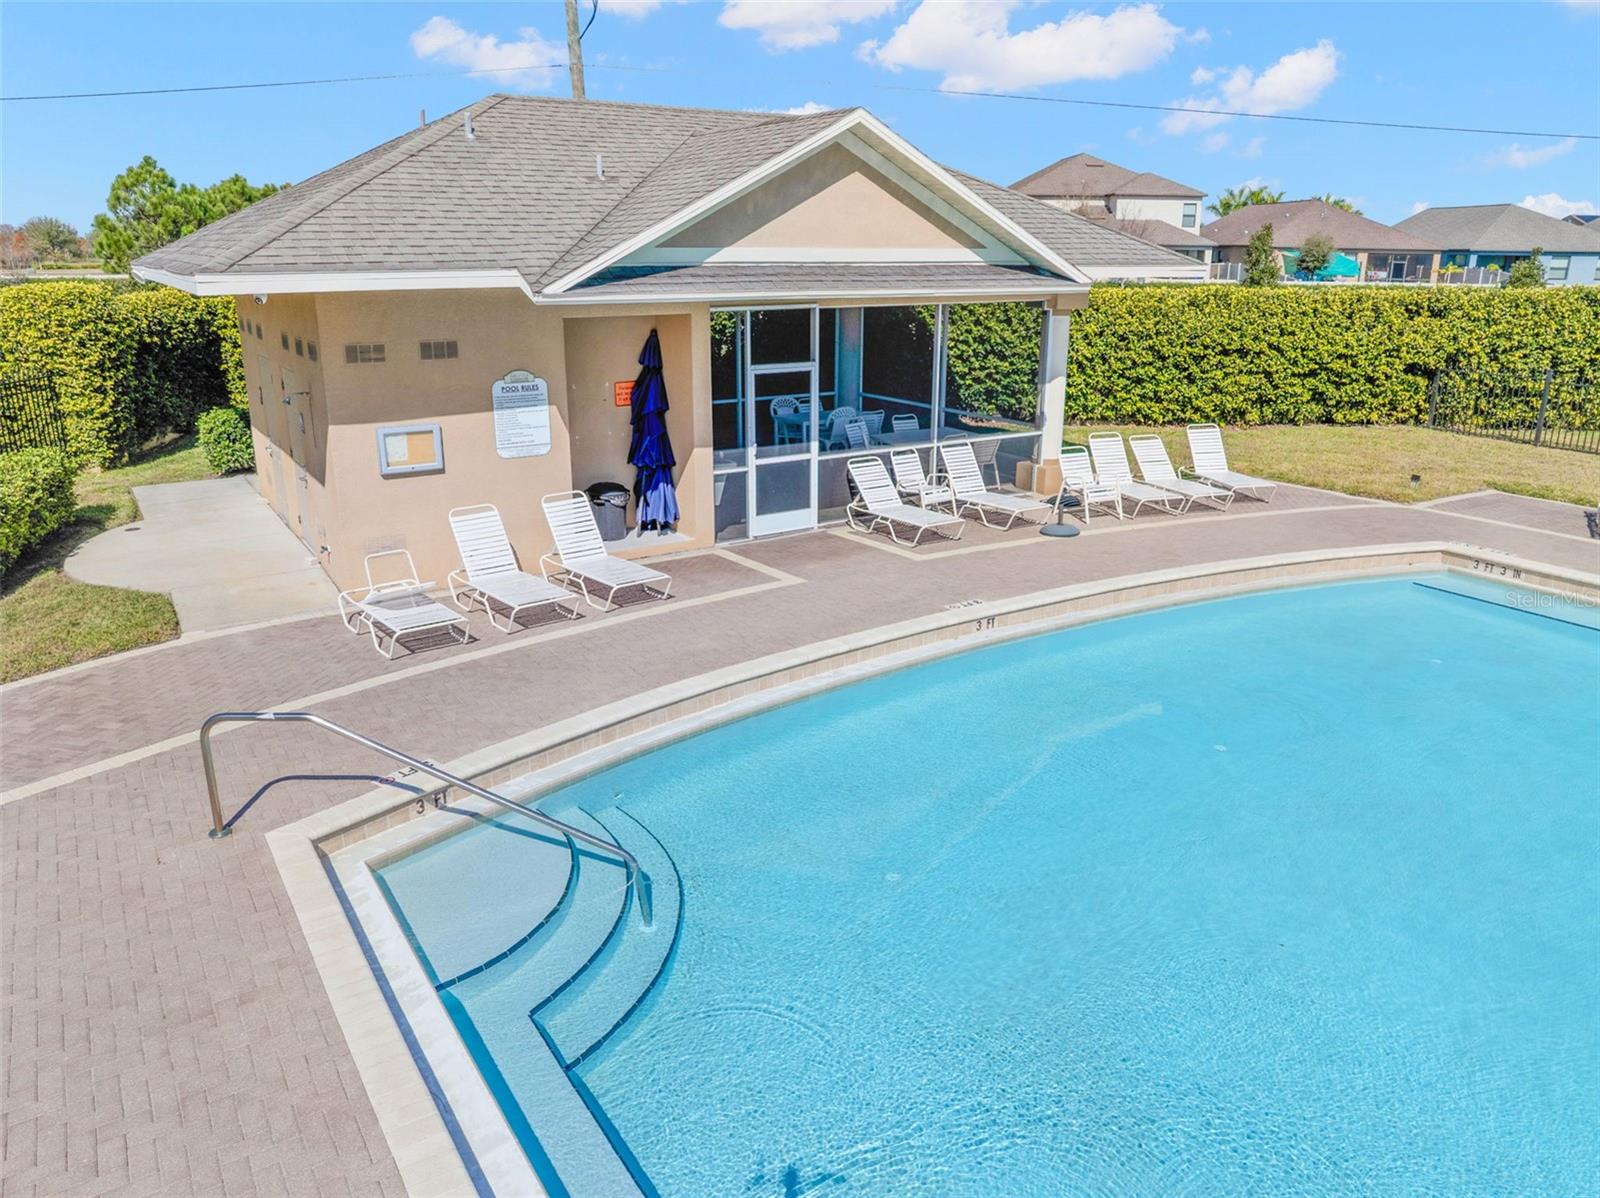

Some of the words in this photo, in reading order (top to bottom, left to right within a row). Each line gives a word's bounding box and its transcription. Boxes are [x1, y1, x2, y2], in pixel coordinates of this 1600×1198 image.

[501, 385, 519, 393] POOL
[521, 384, 539, 392] RULES
[1473, 560, 1479, 569] 3
[1484, 563, 1495, 573] FT
[1500, 566, 1506, 575] 3
[1513, 568, 1522, 578] IN
[976, 620, 982, 631] 3
[986, 617, 995, 629] FT
[416, 799, 425, 814] 3
[433, 790, 447, 807] FT
